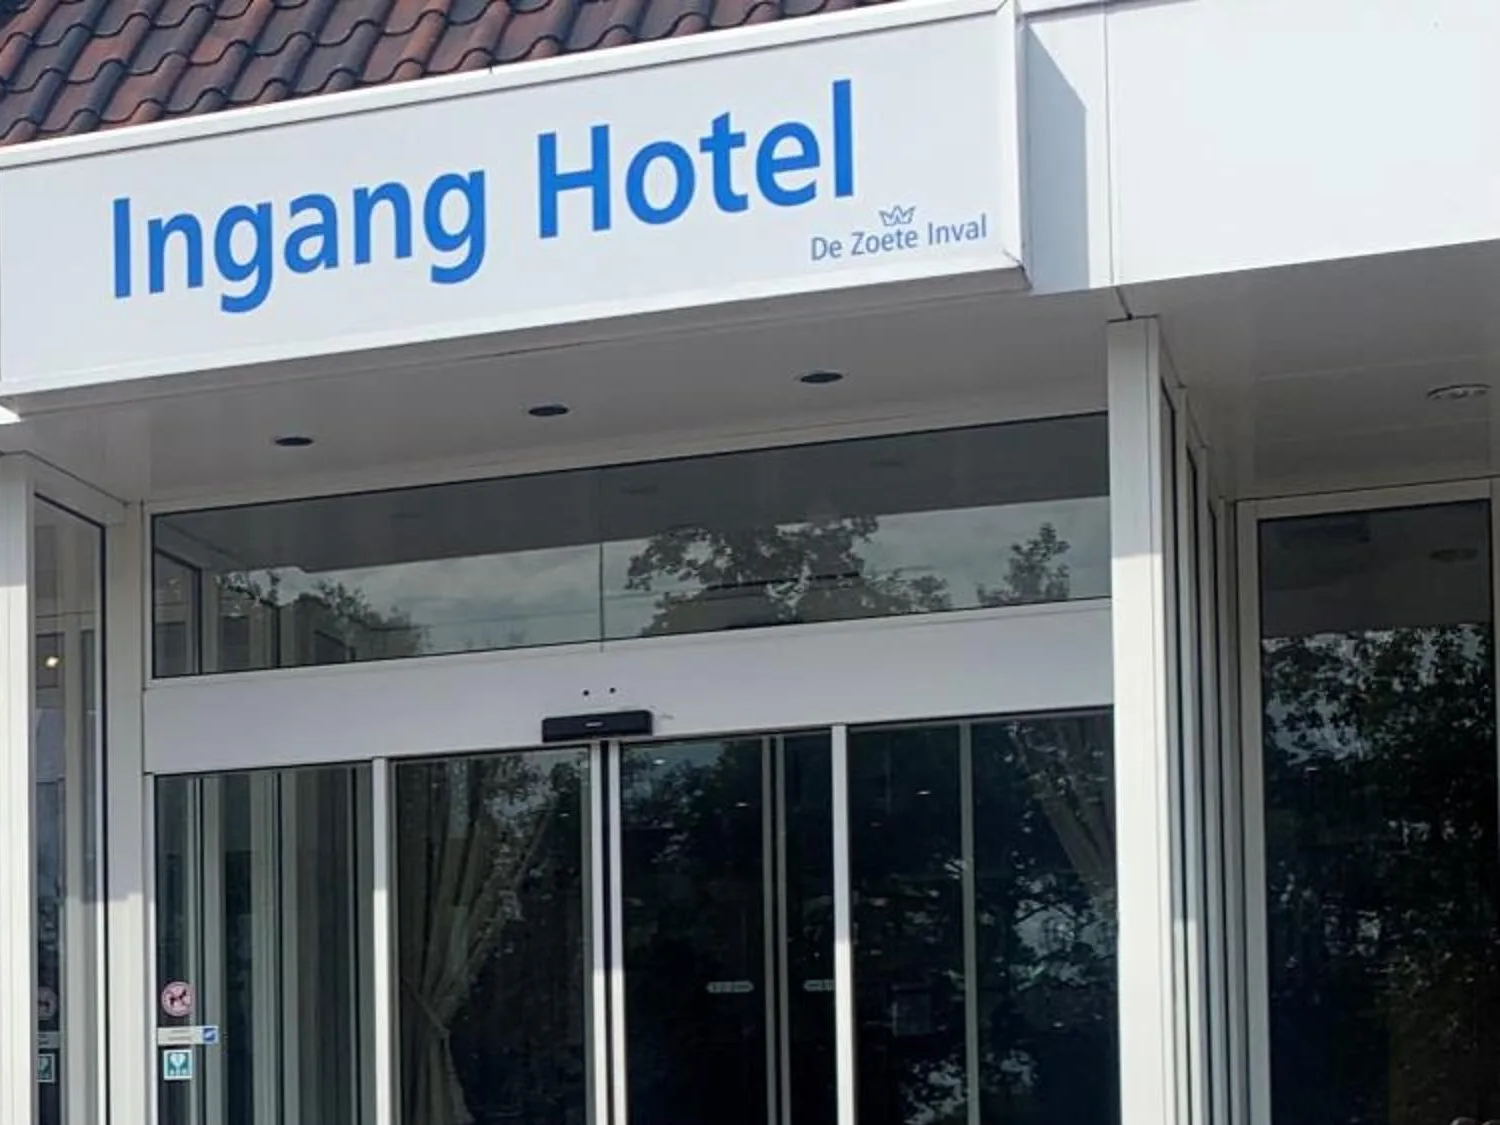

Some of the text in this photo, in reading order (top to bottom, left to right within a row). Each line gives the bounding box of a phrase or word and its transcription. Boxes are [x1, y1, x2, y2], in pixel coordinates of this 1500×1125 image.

[111, 78, 856, 315] Ingang Hotel
[810, 212, 987, 261] De Zoete Inval
